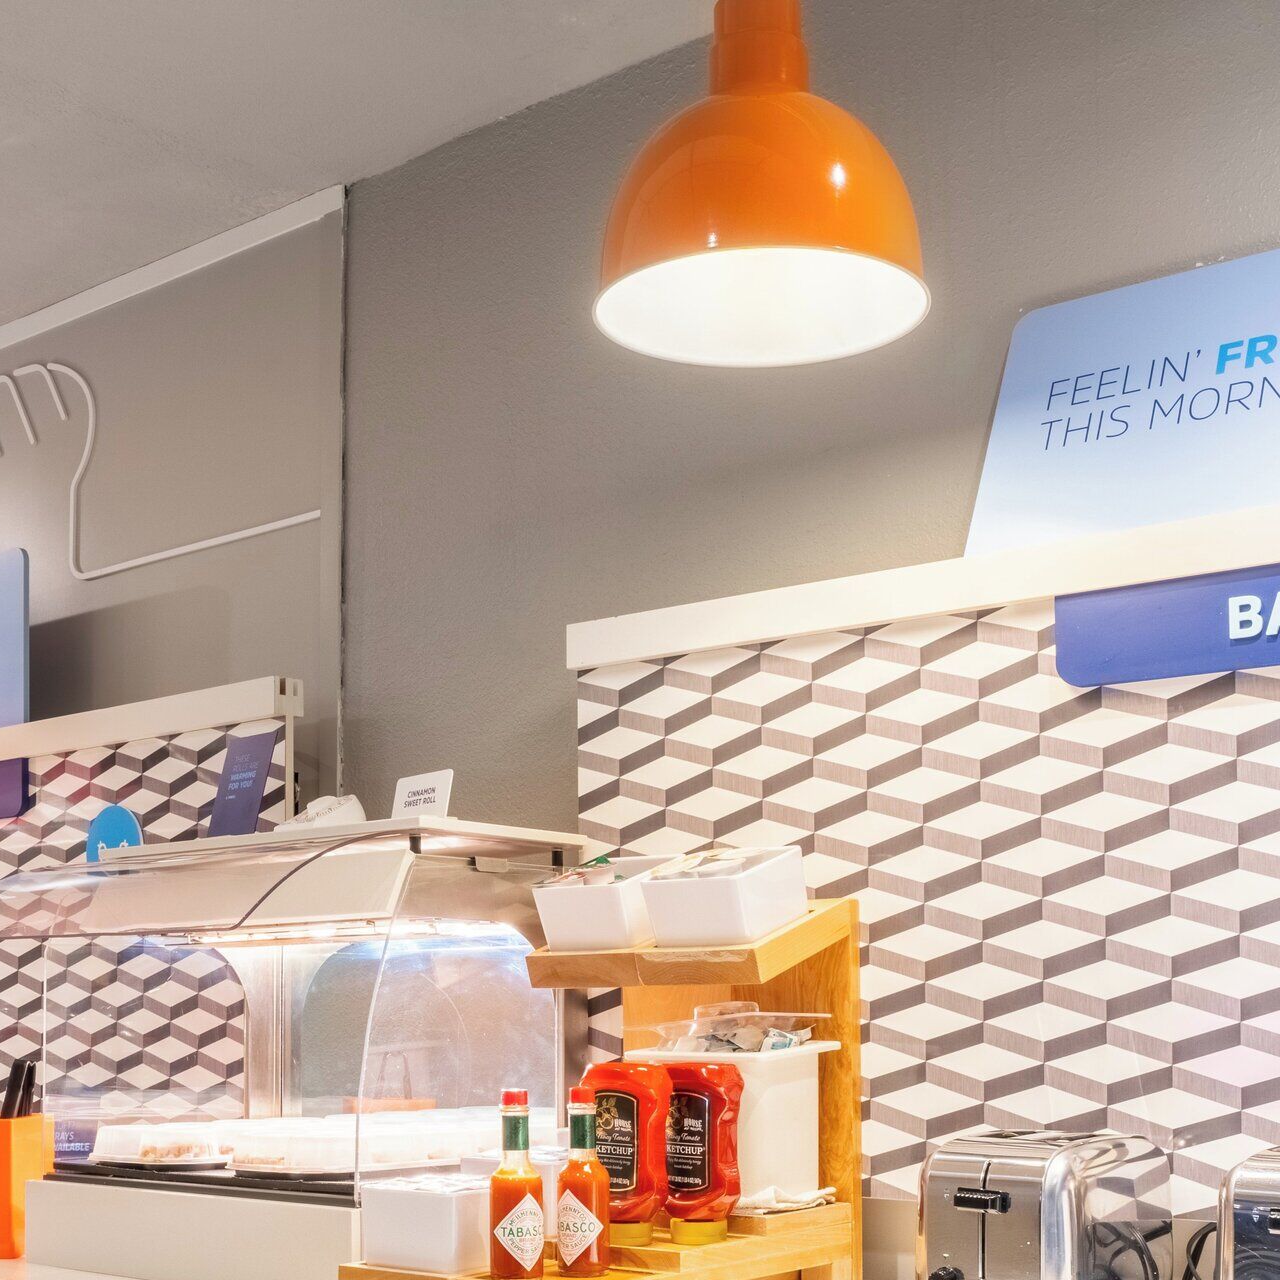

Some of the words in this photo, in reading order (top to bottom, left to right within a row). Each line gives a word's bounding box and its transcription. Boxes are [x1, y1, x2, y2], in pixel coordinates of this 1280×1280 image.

[1046, 349, 1201, 411] FEELIN'
[1040, 414, 1129, 451] THIS
[227, 782, 240, 791] FOR
[407, 786, 437, 799] CINNAMON
[403, 798, 422, 809] SWEET
[422, 796, 436, 806] ROLL
[55, 1131, 74, 1141] RAYS
[55, 1142, 91, 1152] VAILABLE
[596, 1144, 633, 1155] KETCHUP
[666, 1144, 703, 1155] KETCHUP
